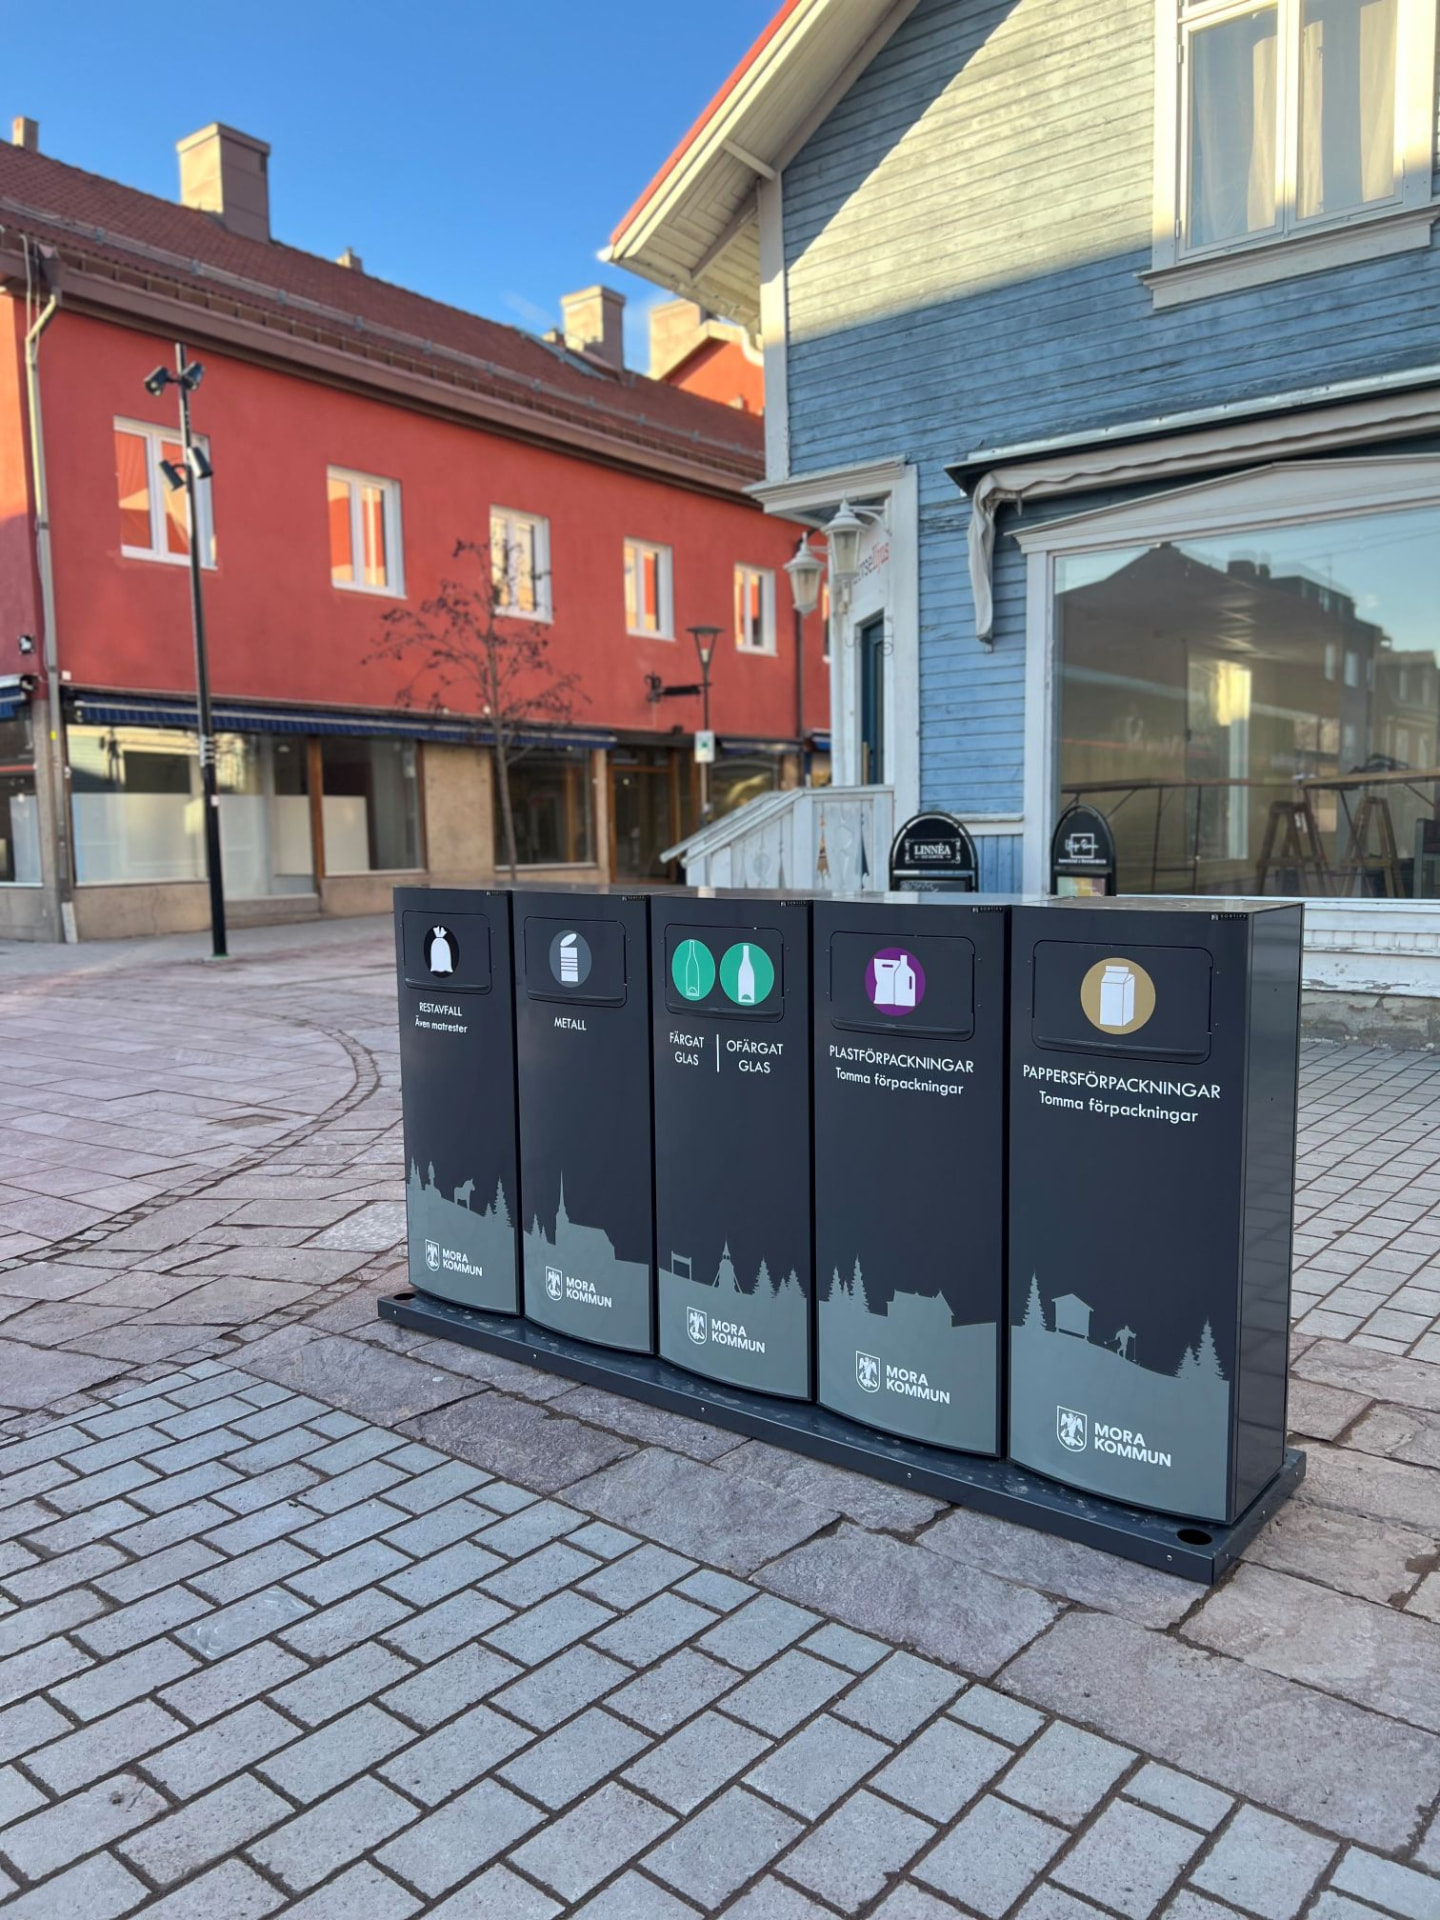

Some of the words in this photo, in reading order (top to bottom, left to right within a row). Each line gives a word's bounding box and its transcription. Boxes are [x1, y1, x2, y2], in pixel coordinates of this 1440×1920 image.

[914, 842, 952, 856] LINNÉA
[418, 1001, 463, 1017] RESTAVFALL
[414, 1014, 431, 1030] Även
[431, 1021, 468, 1033] matrester
[553, 1016, 587, 1031] METALL
[669, 1030, 705, 1049] FÄRGAT
[726, 1037, 784, 1055] OFÄRGAT
[674, 1050, 700, 1066] GLAS
[738, 1059, 771, 1074] GLAS
[829, 1044, 974, 1073] PLASTFÖRPACKNINGAR
[835, 1066, 871, 1084] Tomma
[874, 1072, 964, 1097] förpackningar
[1022, 1063, 1222, 1100] PAPPERSFÖRPACKNINGAR
[1038, 1089, 1084, 1111] Tomma
[1088, 1097, 1199, 1125] förpackningar
[442, 1248, 469, 1263] MORA
[442, 1259, 483, 1277] KOMMUN
[565, 1276, 596, 1293] MORA
[565, 1288, 613, 1309] KOMMUN
[711, 1318, 747, 1337] MORA
[711, 1333, 766, 1354] KOMMUN
[886, 1364, 929, 1386] MORA
[886, 1379, 951, 1406] KOMMUN
[1094, 1421, 1147, 1447] MORA
[1093, 1438, 1173, 1468] KOMMUN
